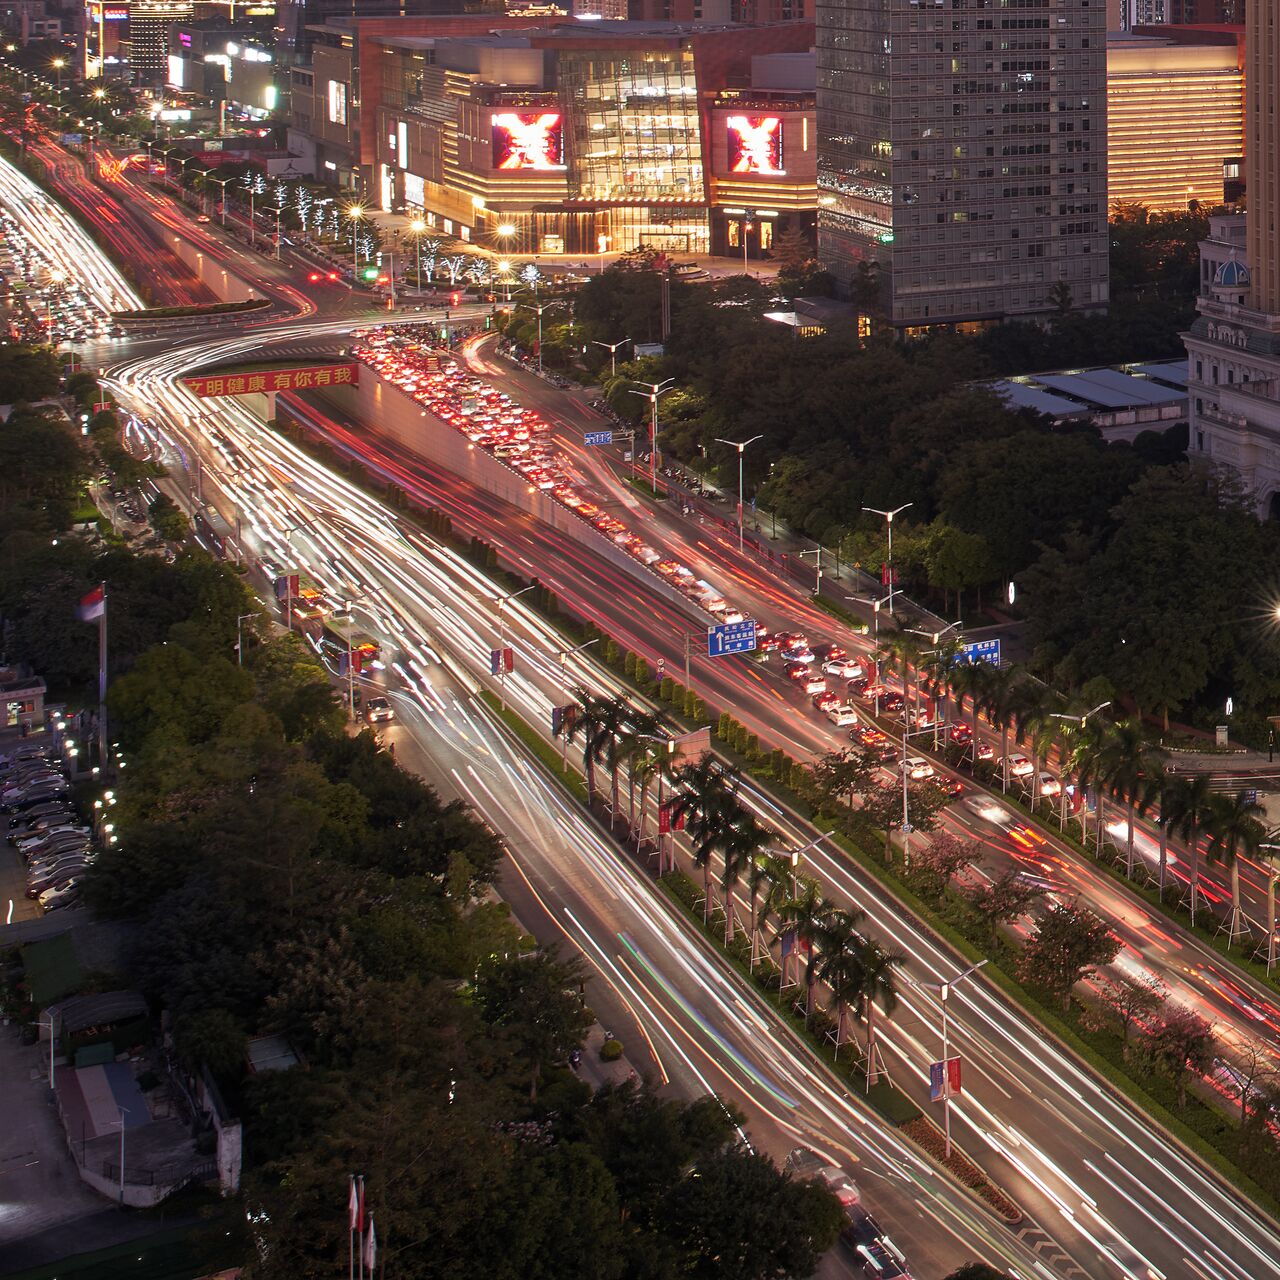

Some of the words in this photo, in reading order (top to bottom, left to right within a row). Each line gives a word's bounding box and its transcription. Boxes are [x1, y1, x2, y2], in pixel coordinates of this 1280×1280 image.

[188, 376, 266, 396] 文明健康
[274, 367, 352, 389] 有你有我
